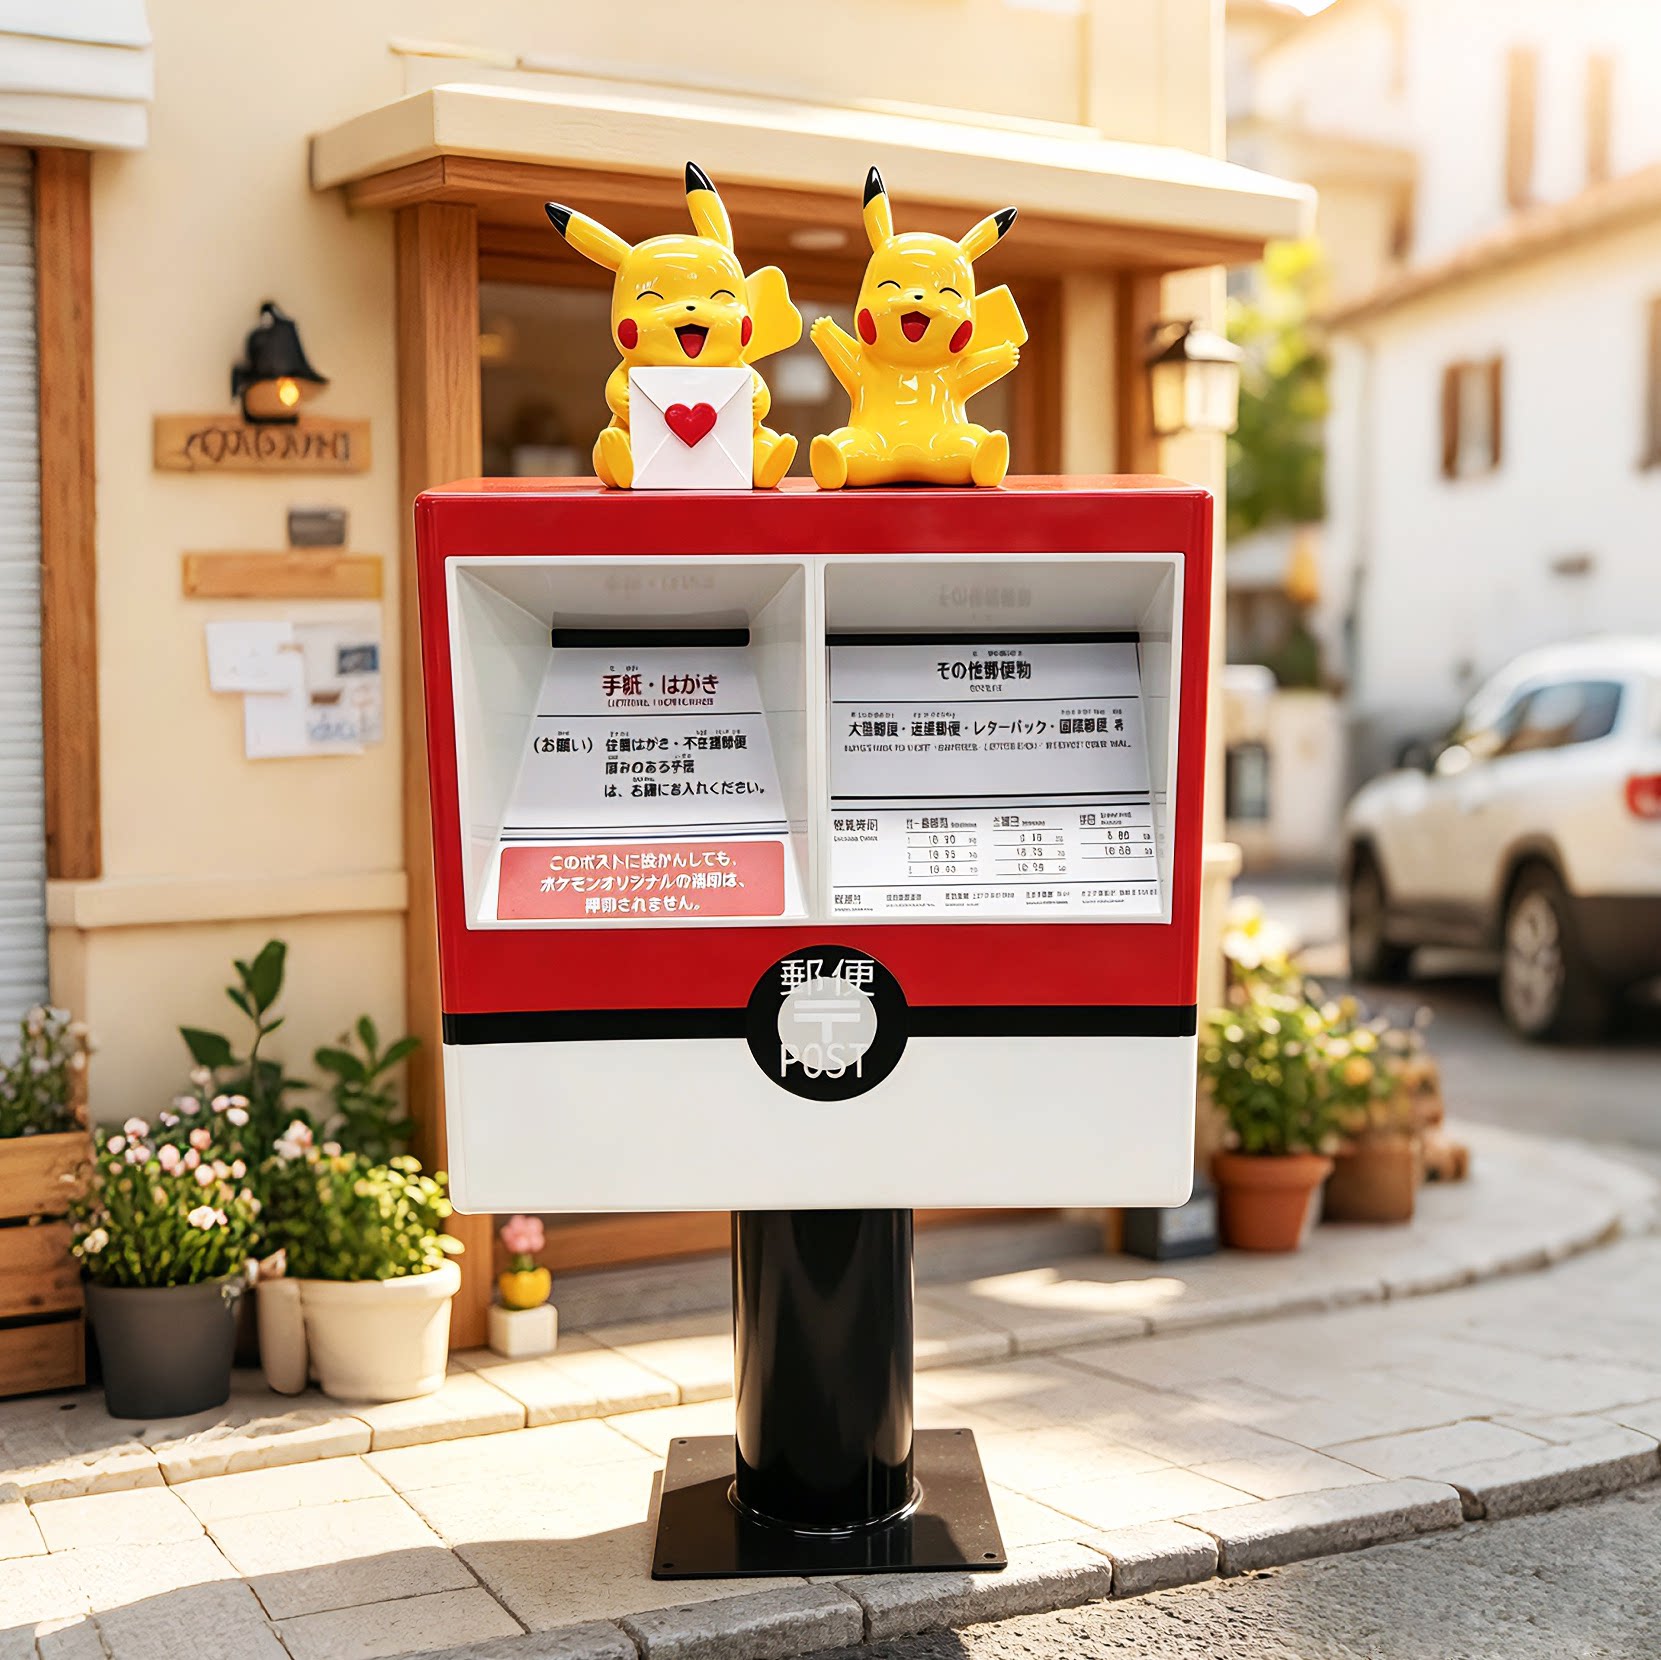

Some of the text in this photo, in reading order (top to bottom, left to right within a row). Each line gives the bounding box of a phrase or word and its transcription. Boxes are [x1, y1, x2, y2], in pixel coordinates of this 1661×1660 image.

[602, 673, 720, 697] 手紙・はがき
[780, 958, 876, 997] 郵便
[780, 1042, 870, 1079] POST
